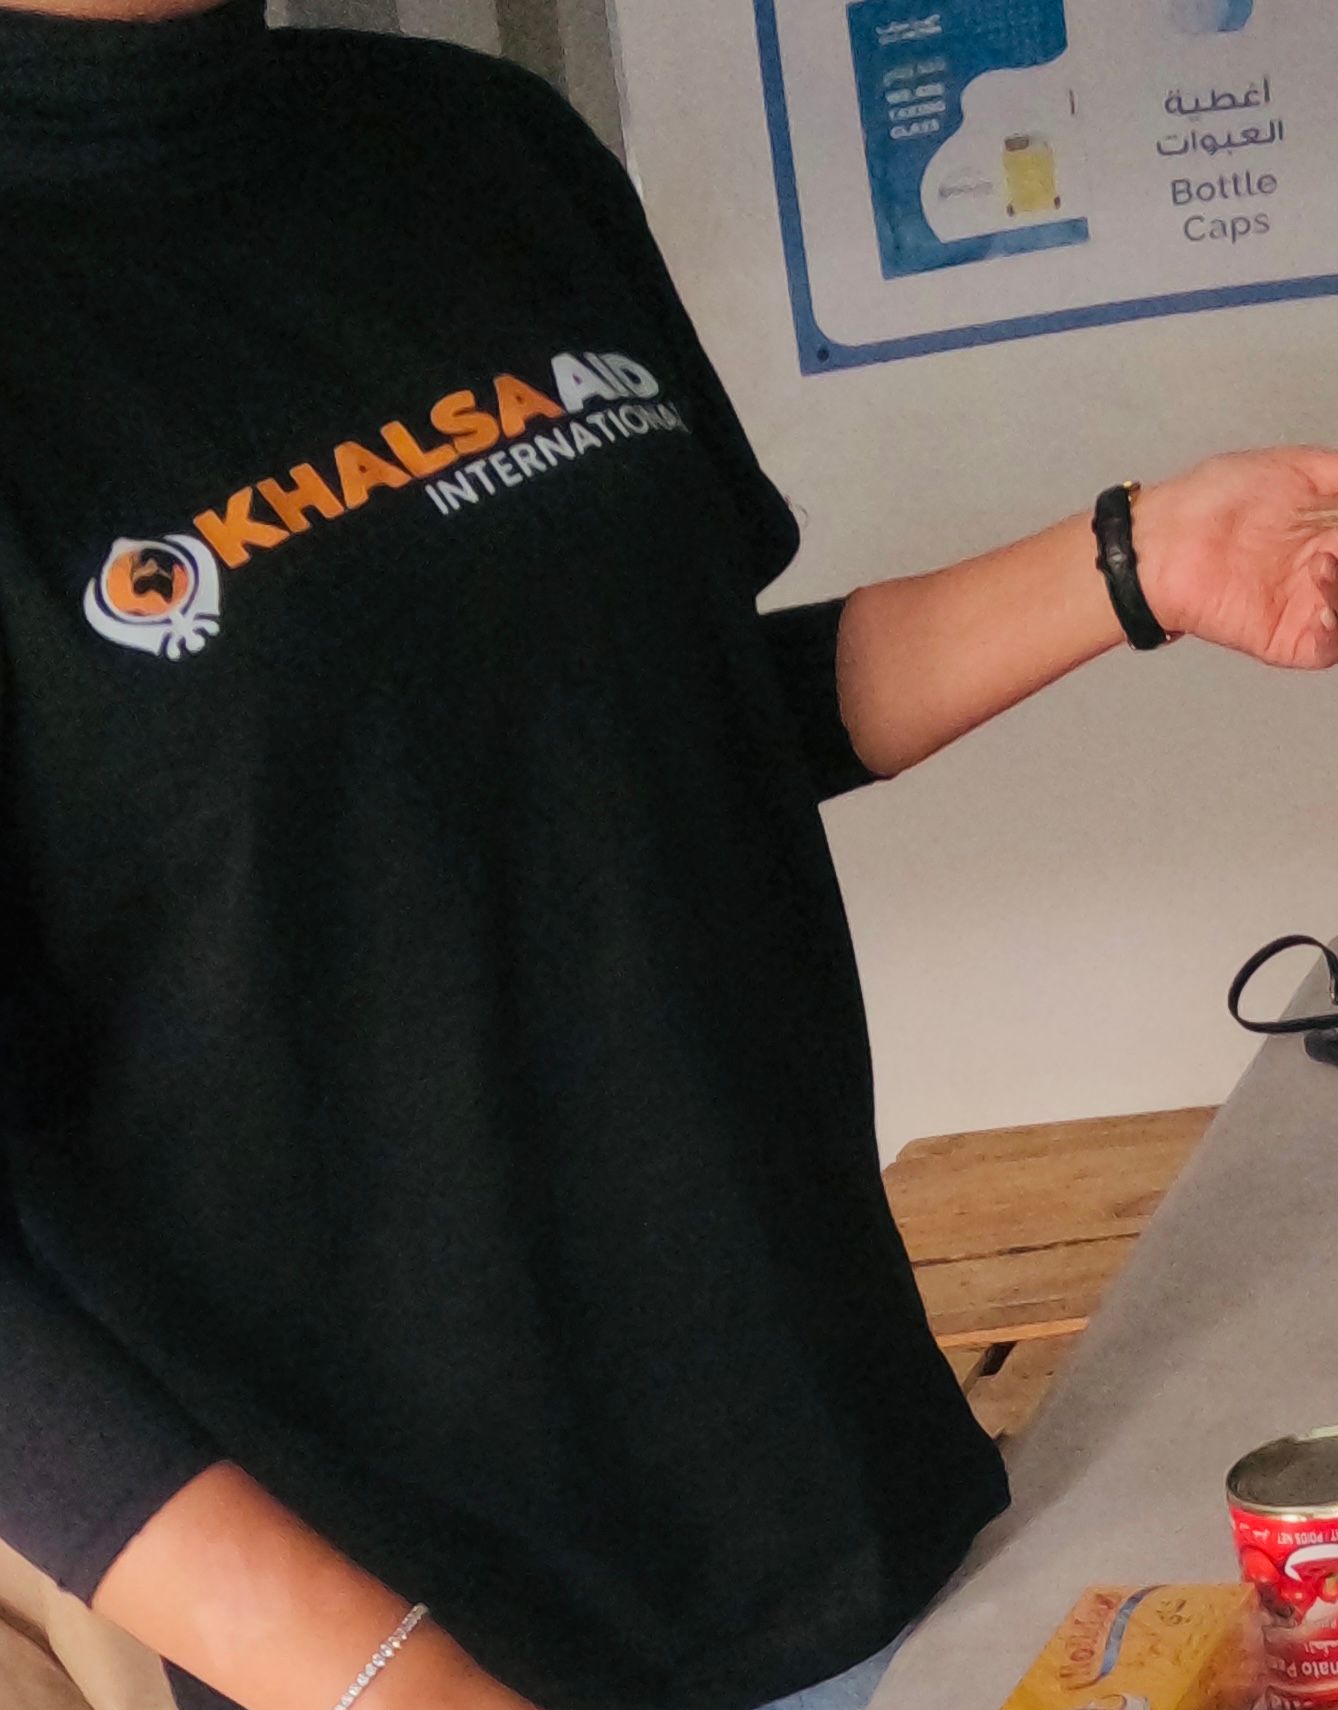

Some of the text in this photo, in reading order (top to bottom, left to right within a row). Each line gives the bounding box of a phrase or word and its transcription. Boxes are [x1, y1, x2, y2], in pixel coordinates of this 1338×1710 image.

[1165, 73, 1270, 120] أغطية
[1156, 119, 1284, 157] العبوات
[1170, 170, 1278, 206] Bottle
[1183, 211, 1271, 243] Caps
